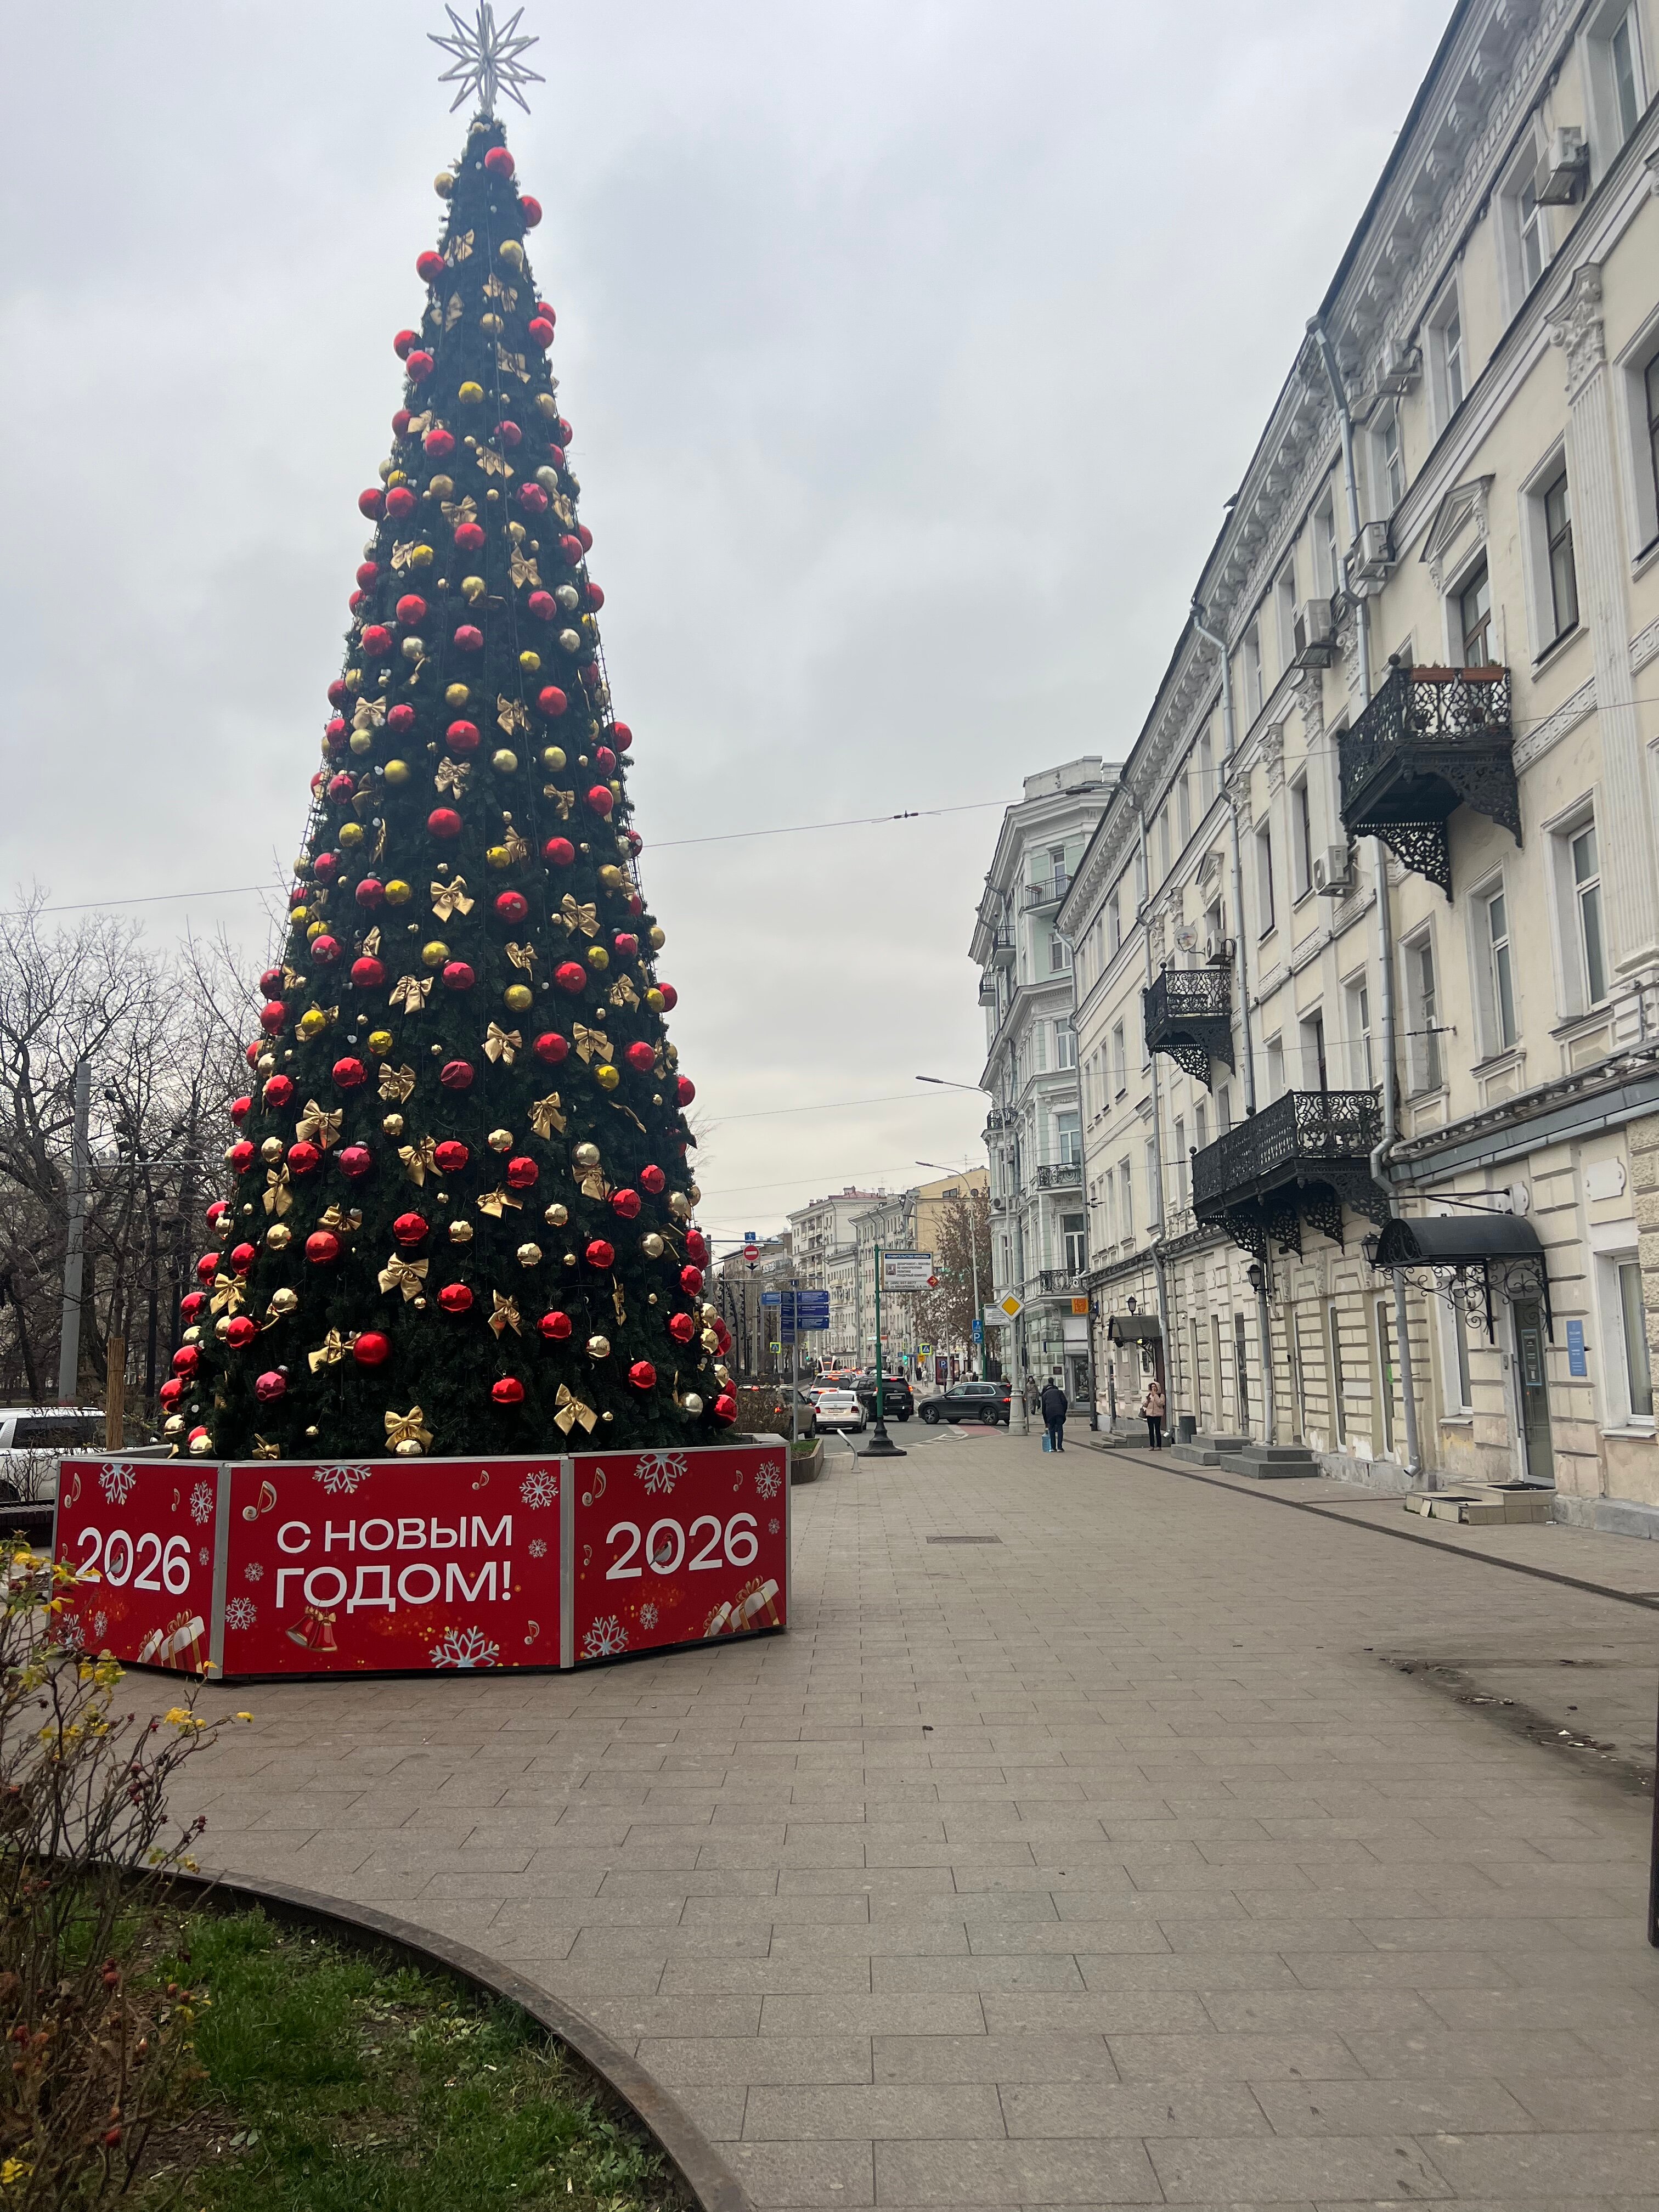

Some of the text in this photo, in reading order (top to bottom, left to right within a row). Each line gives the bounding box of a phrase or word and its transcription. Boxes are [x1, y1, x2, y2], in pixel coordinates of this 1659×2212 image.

[974, 1333, 980, 1342] P
[276, 1514, 513, 1553] С НОВЫМ
[606, 1513, 759, 1580] 2026
[75, 1527, 191, 1595] 2026
[276, 1561, 511, 1614] ГОДОМ!
